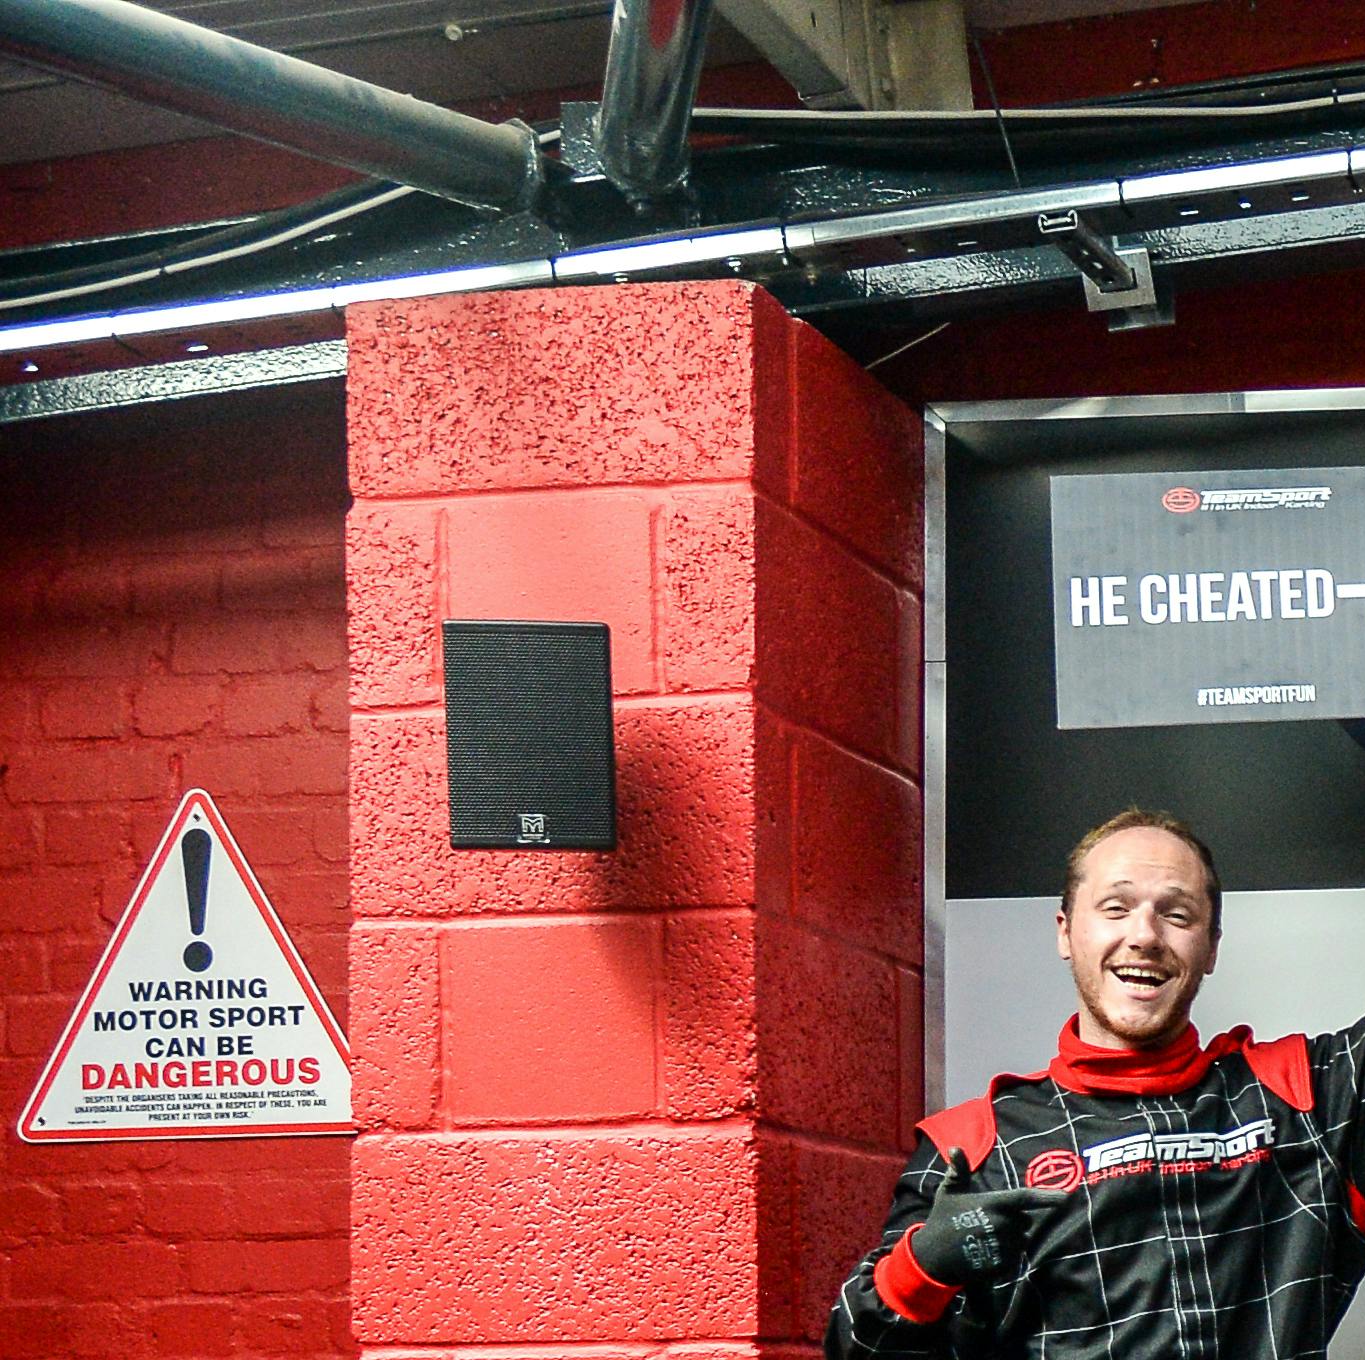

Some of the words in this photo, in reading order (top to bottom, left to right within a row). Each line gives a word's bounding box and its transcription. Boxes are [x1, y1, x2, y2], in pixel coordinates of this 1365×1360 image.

[1070, 576, 1129, 627] HE
[1140, 569, 1336, 625] CHEATED
[1197, 685, 1317, 707] #TEAMSPORTFUN
[129, 978, 267, 1002] WARNING
[94, 1009, 198, 1031] MOTOR
[209, 1006, 304, 1029] SPORT
[146, 1036, 205, 1058] CAN
[217, 1035, 253, 1056] BE
[82, 1058, 320, 1090] DANGEROUS
[1082, 1118, 1276, 1172] TeamSport
